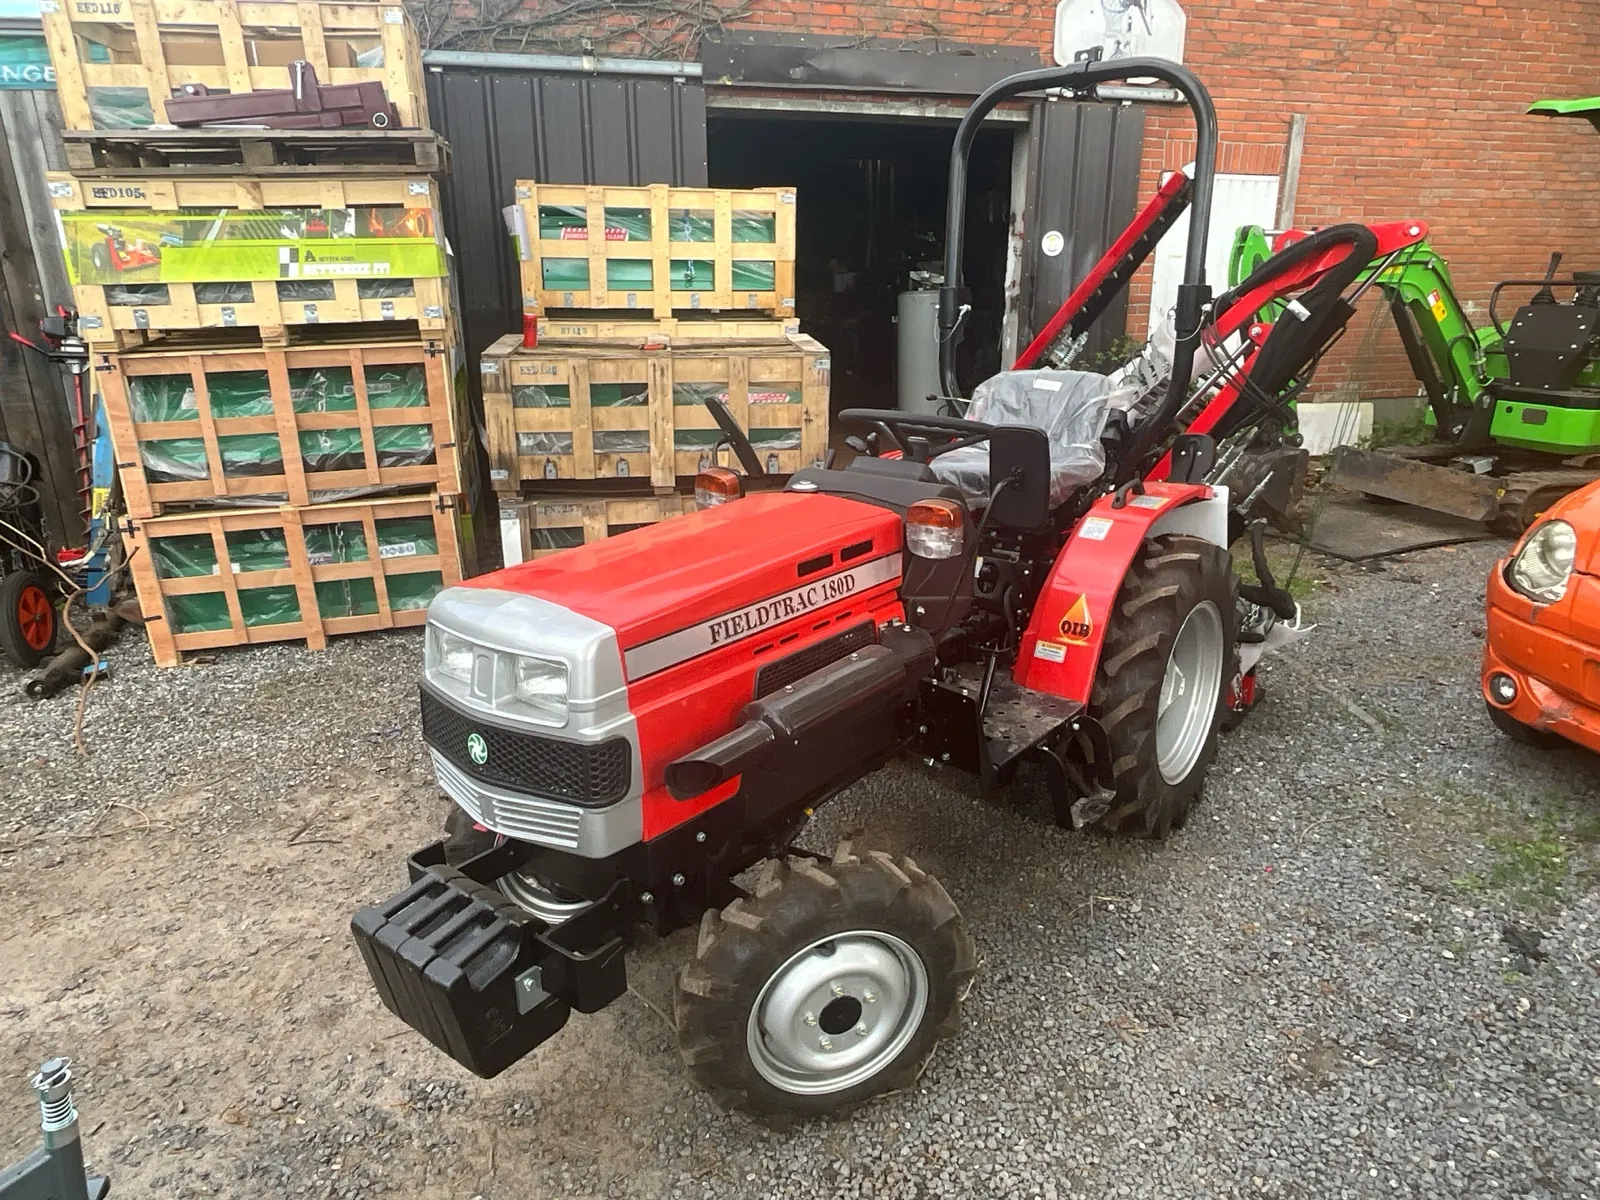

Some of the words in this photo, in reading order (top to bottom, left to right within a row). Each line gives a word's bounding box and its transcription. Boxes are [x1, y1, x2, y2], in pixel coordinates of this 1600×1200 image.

[708, 587, 818, 645] FIELDTRAC
[821, 574, 856, 601] 180D
[1060, 620, 1090, 638] OIB
